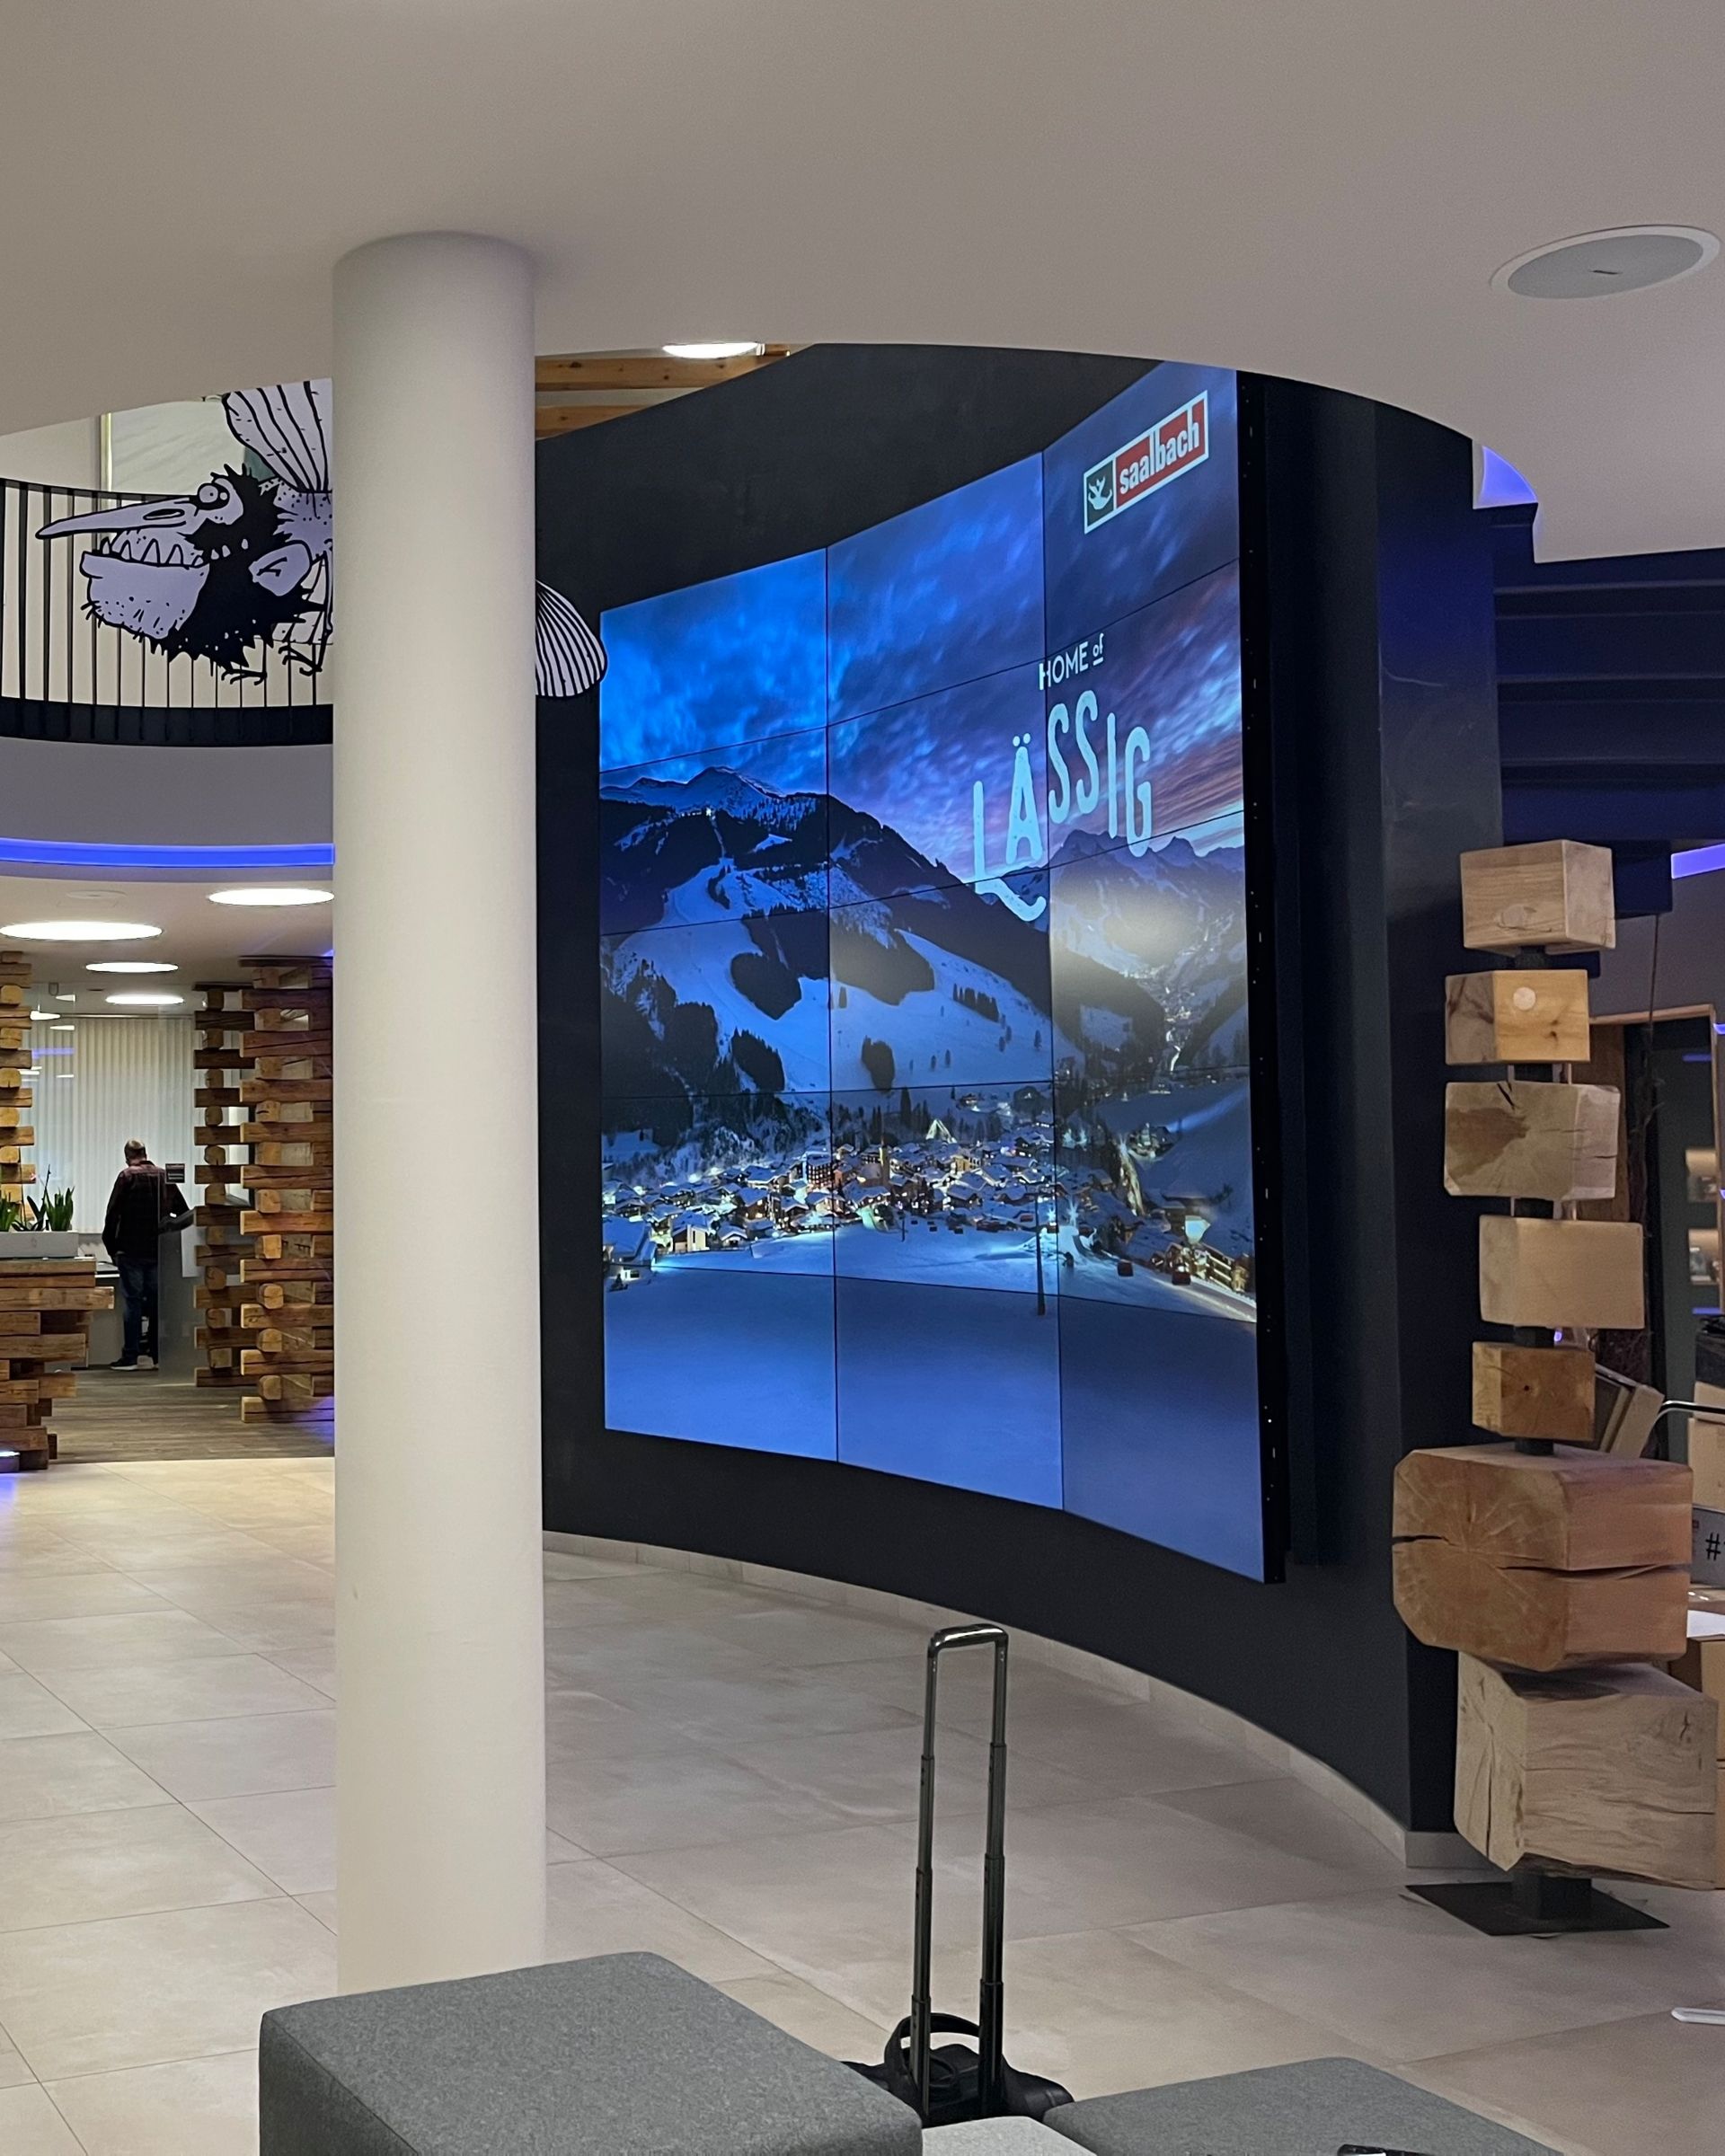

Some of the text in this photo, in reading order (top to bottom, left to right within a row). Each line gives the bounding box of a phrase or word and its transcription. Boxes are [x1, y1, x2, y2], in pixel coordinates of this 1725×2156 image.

[1119, 406, 1200, 495] saalbach
[1039, 632, 1104, 691] HOME of
[973, 689, 1152, 922] LÄSSIG
